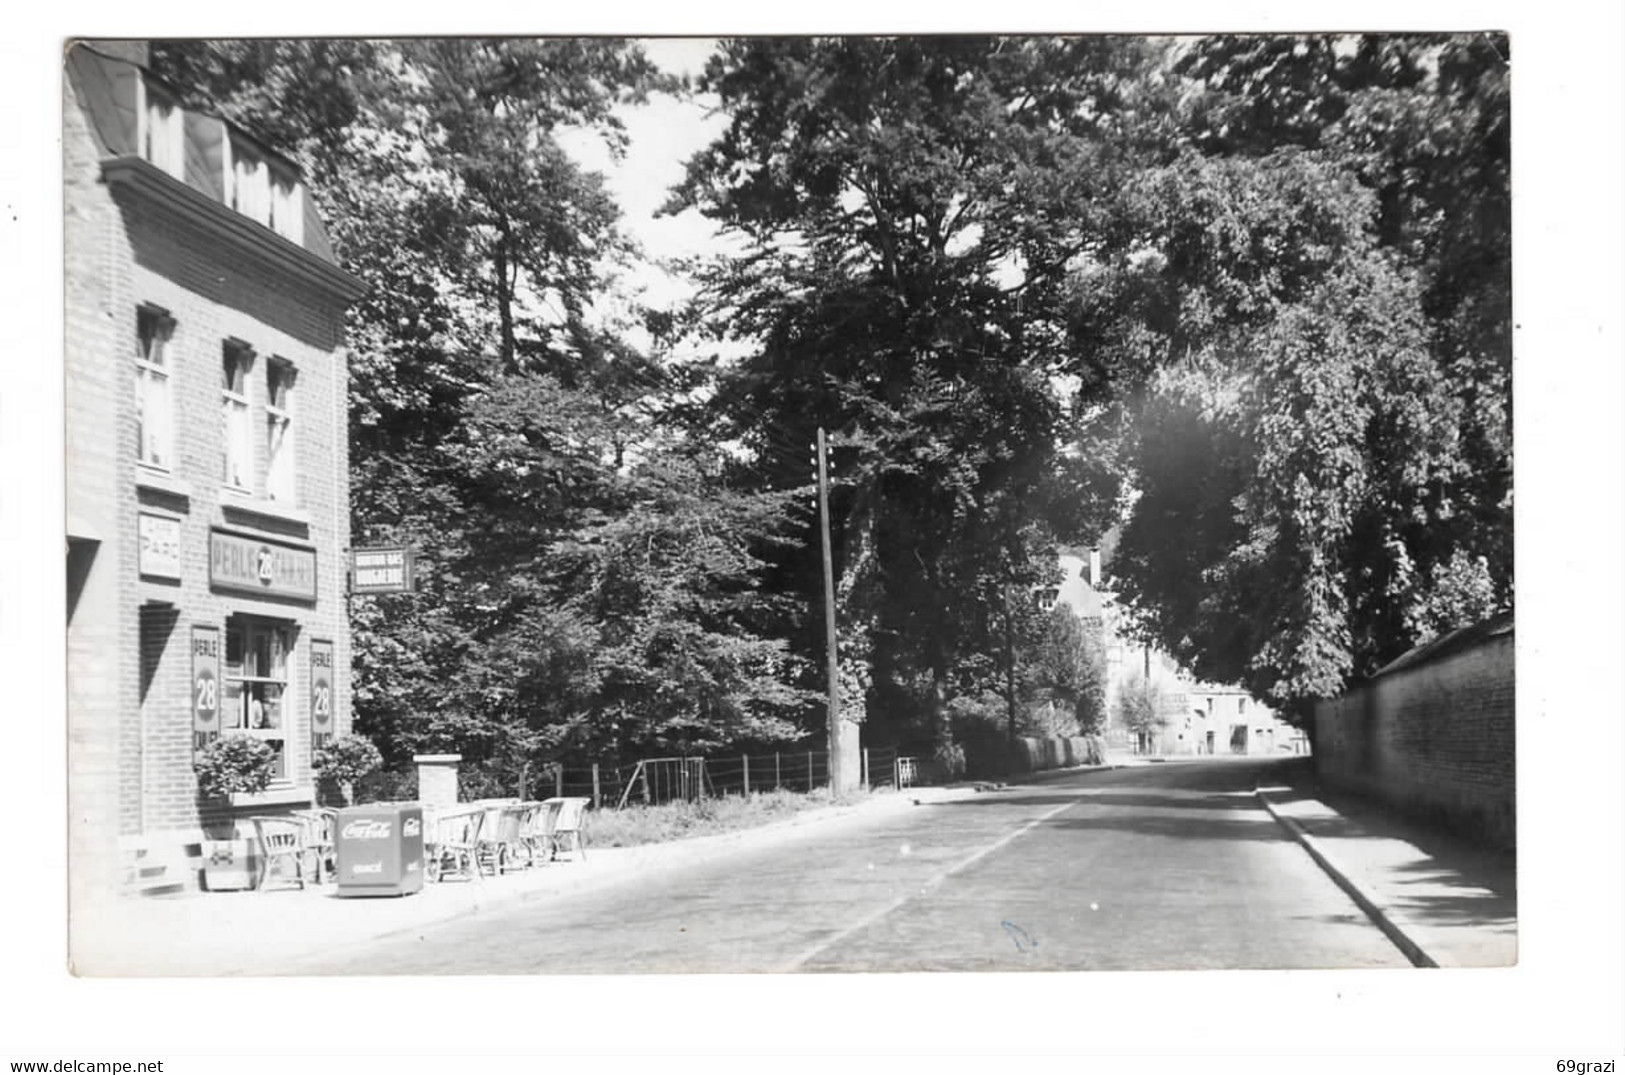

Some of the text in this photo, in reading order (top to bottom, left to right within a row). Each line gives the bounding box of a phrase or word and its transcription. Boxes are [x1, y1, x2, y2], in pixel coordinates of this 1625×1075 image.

[212, 541, 256, 579] PERLE
[259, 551, 273, 579] 28
[194, 638, 217, 658] PERLE
[312, 651, 331, 668] PERLE
[197, 678, 216, 710] 28
[315, 686, 329, 715] 28
